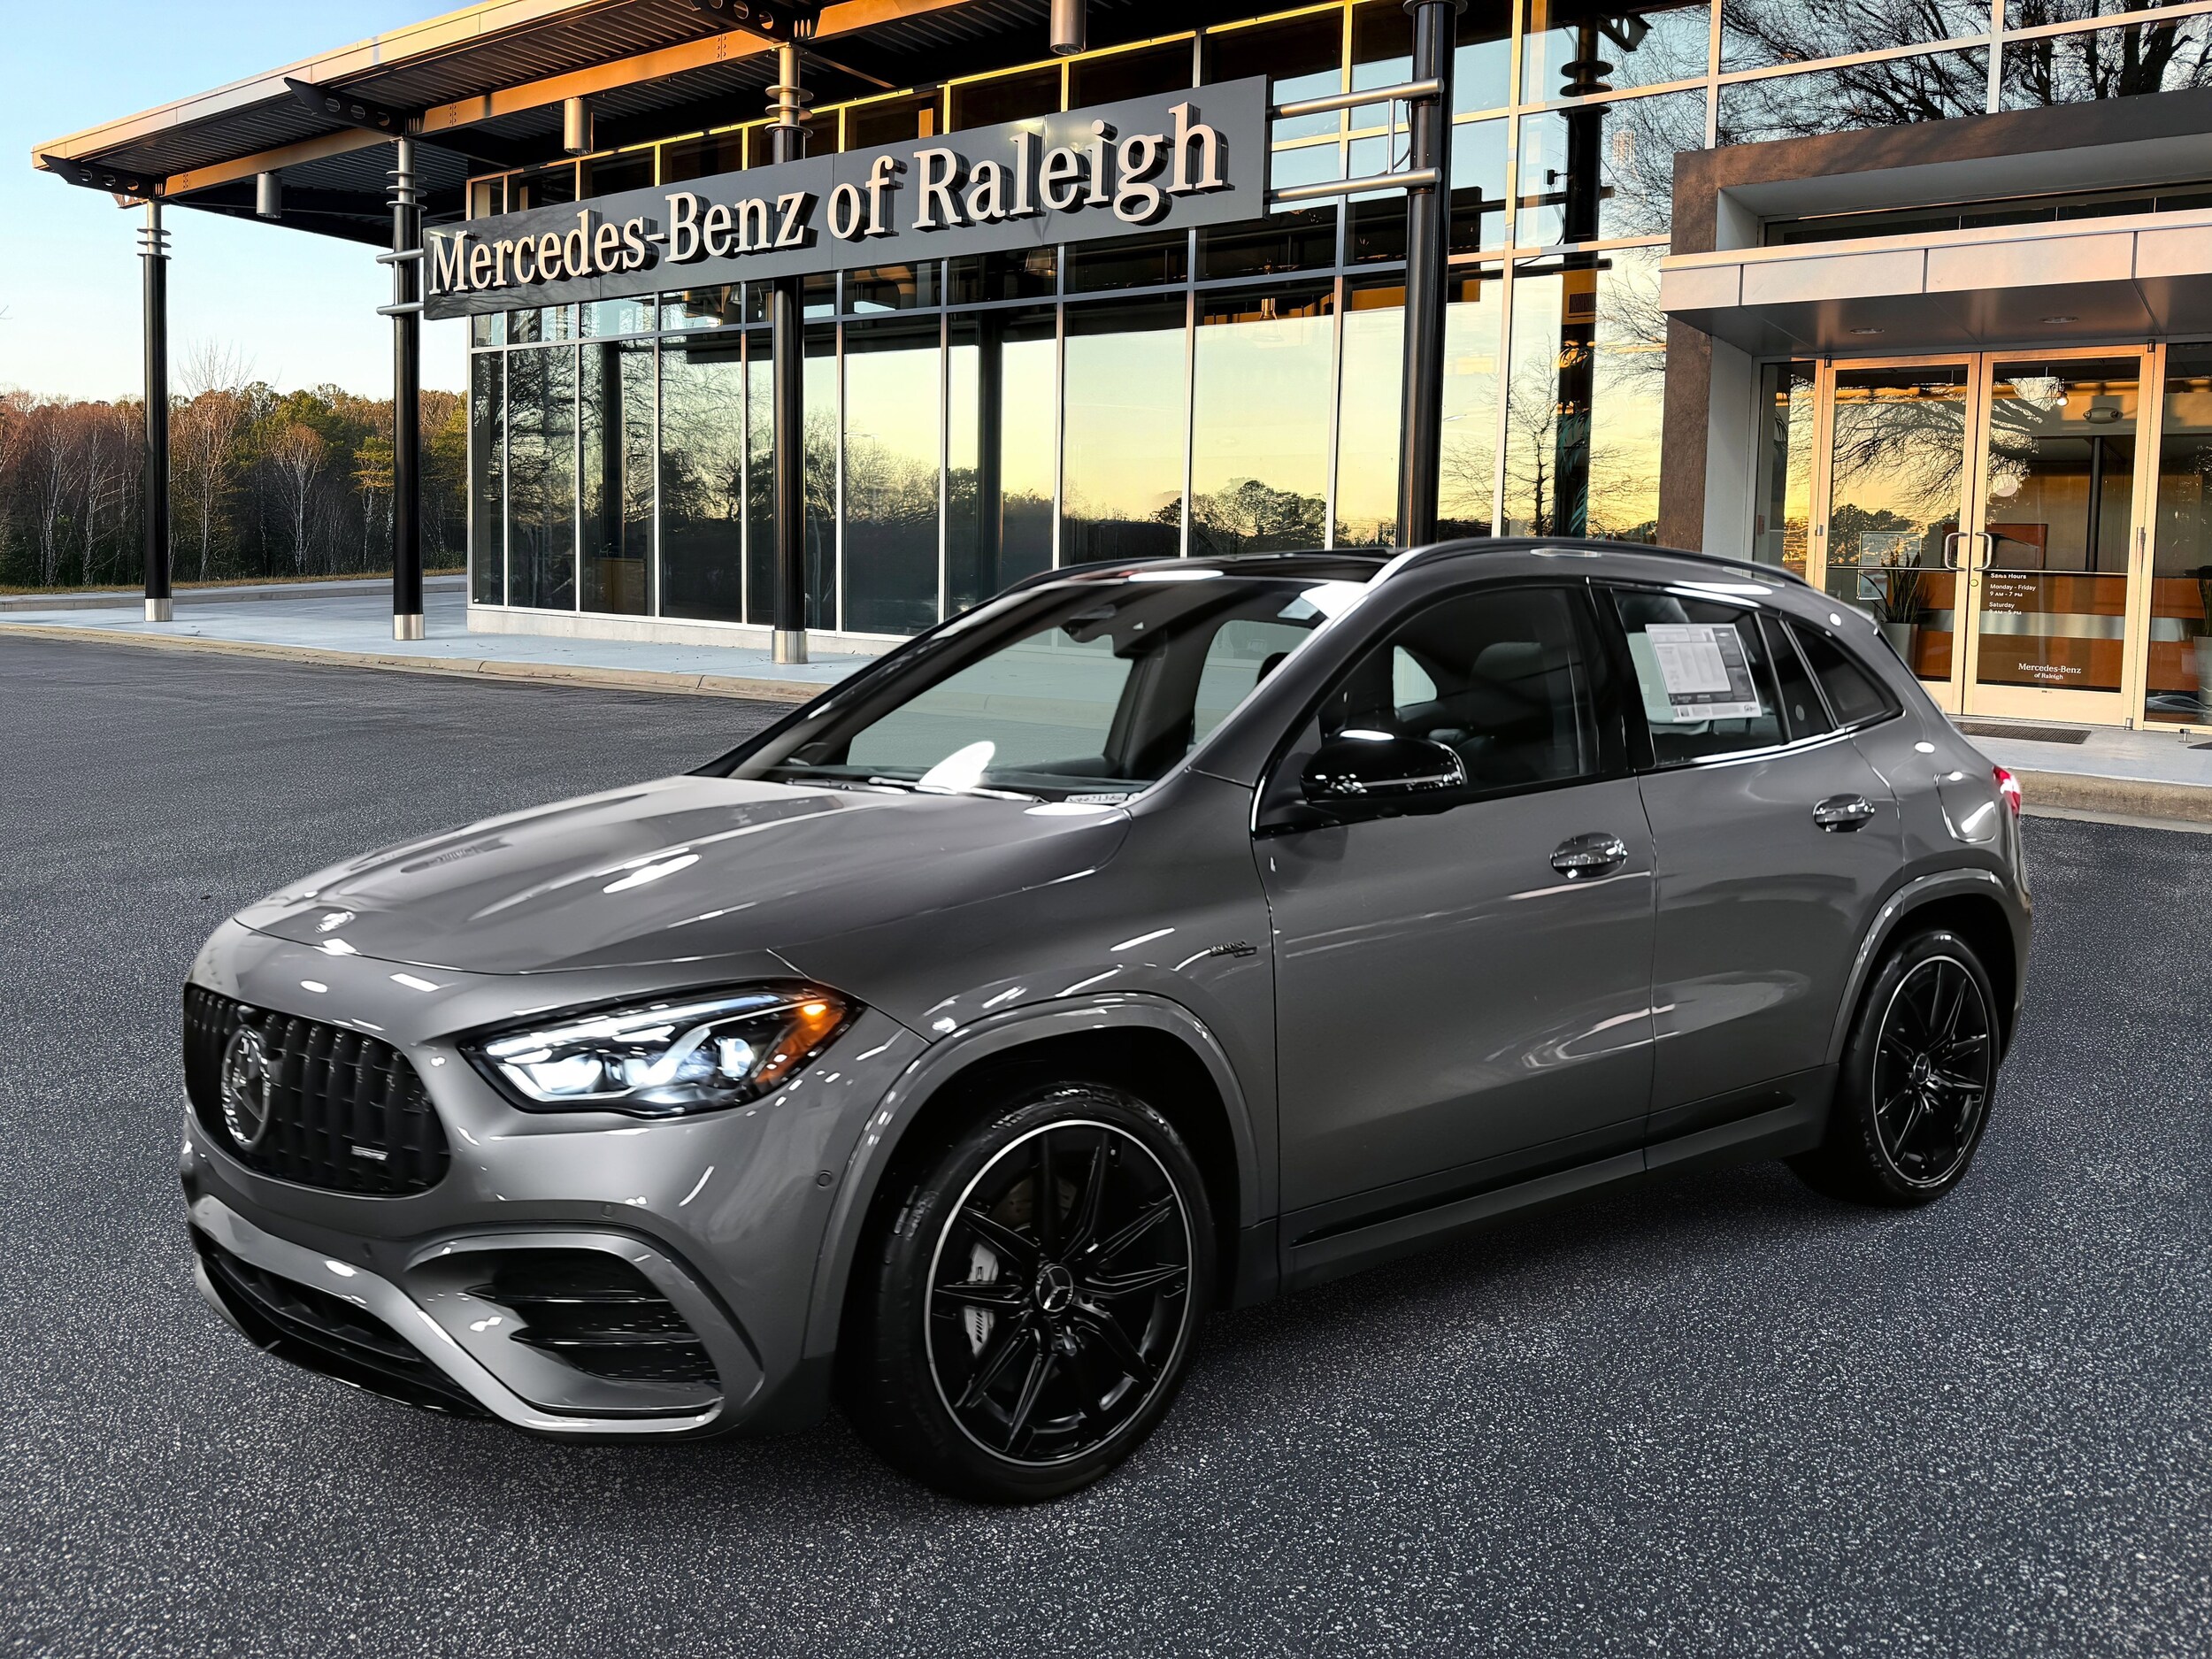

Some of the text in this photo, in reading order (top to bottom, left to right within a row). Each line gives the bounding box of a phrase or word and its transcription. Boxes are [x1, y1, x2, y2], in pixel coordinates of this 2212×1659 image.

[429, 101, 1226, 296] Mercedes-Benz of Raleigh
[2018, 663, 2081, 673] Mercedes-Benz
